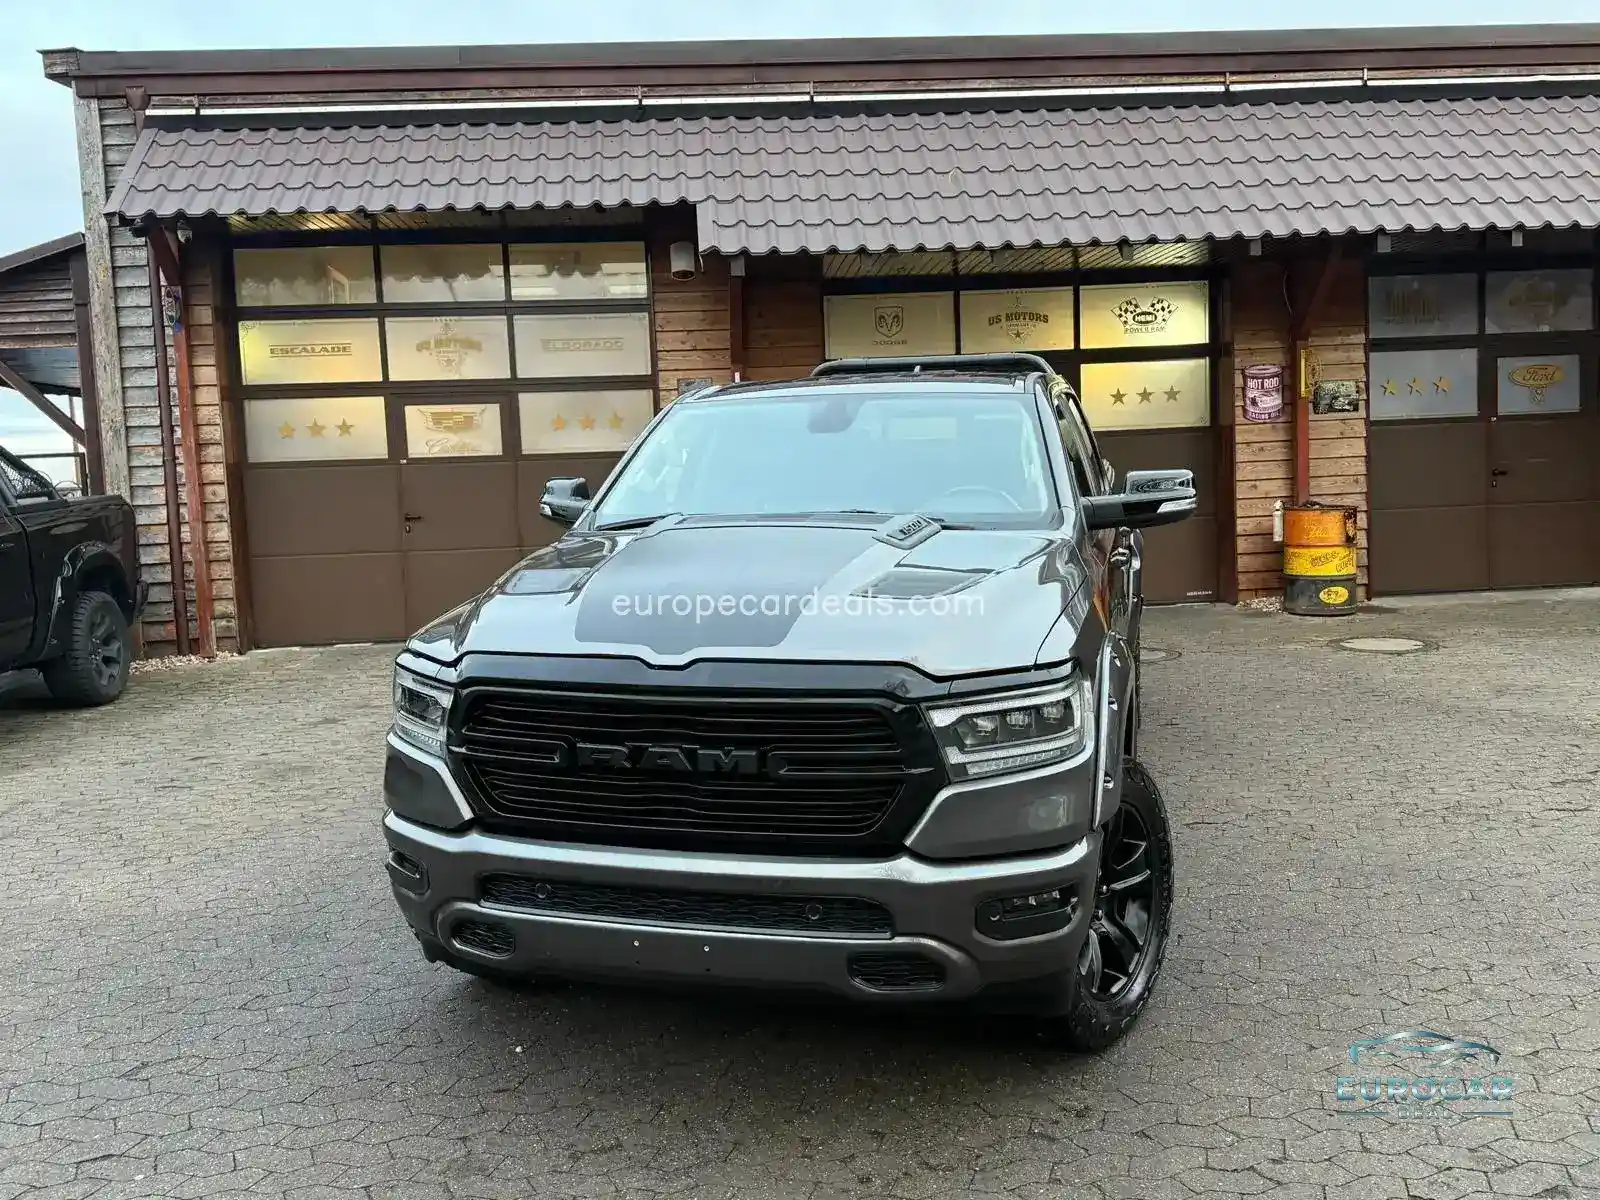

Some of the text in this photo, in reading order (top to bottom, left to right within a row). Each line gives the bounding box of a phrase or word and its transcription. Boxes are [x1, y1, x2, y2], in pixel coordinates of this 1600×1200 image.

[988, 314, 1002, 326] US
[1005, 312, 1048, 323] MOTORS
[270, 346, 352, 354] ESCALADE
[541, 341, 624, 350] ELDORADO
[1523, 367, 1556, 382] Ford
[1247, 377, 1279, 390] HOT ROD
[576, 743, 757, 773] RAM
